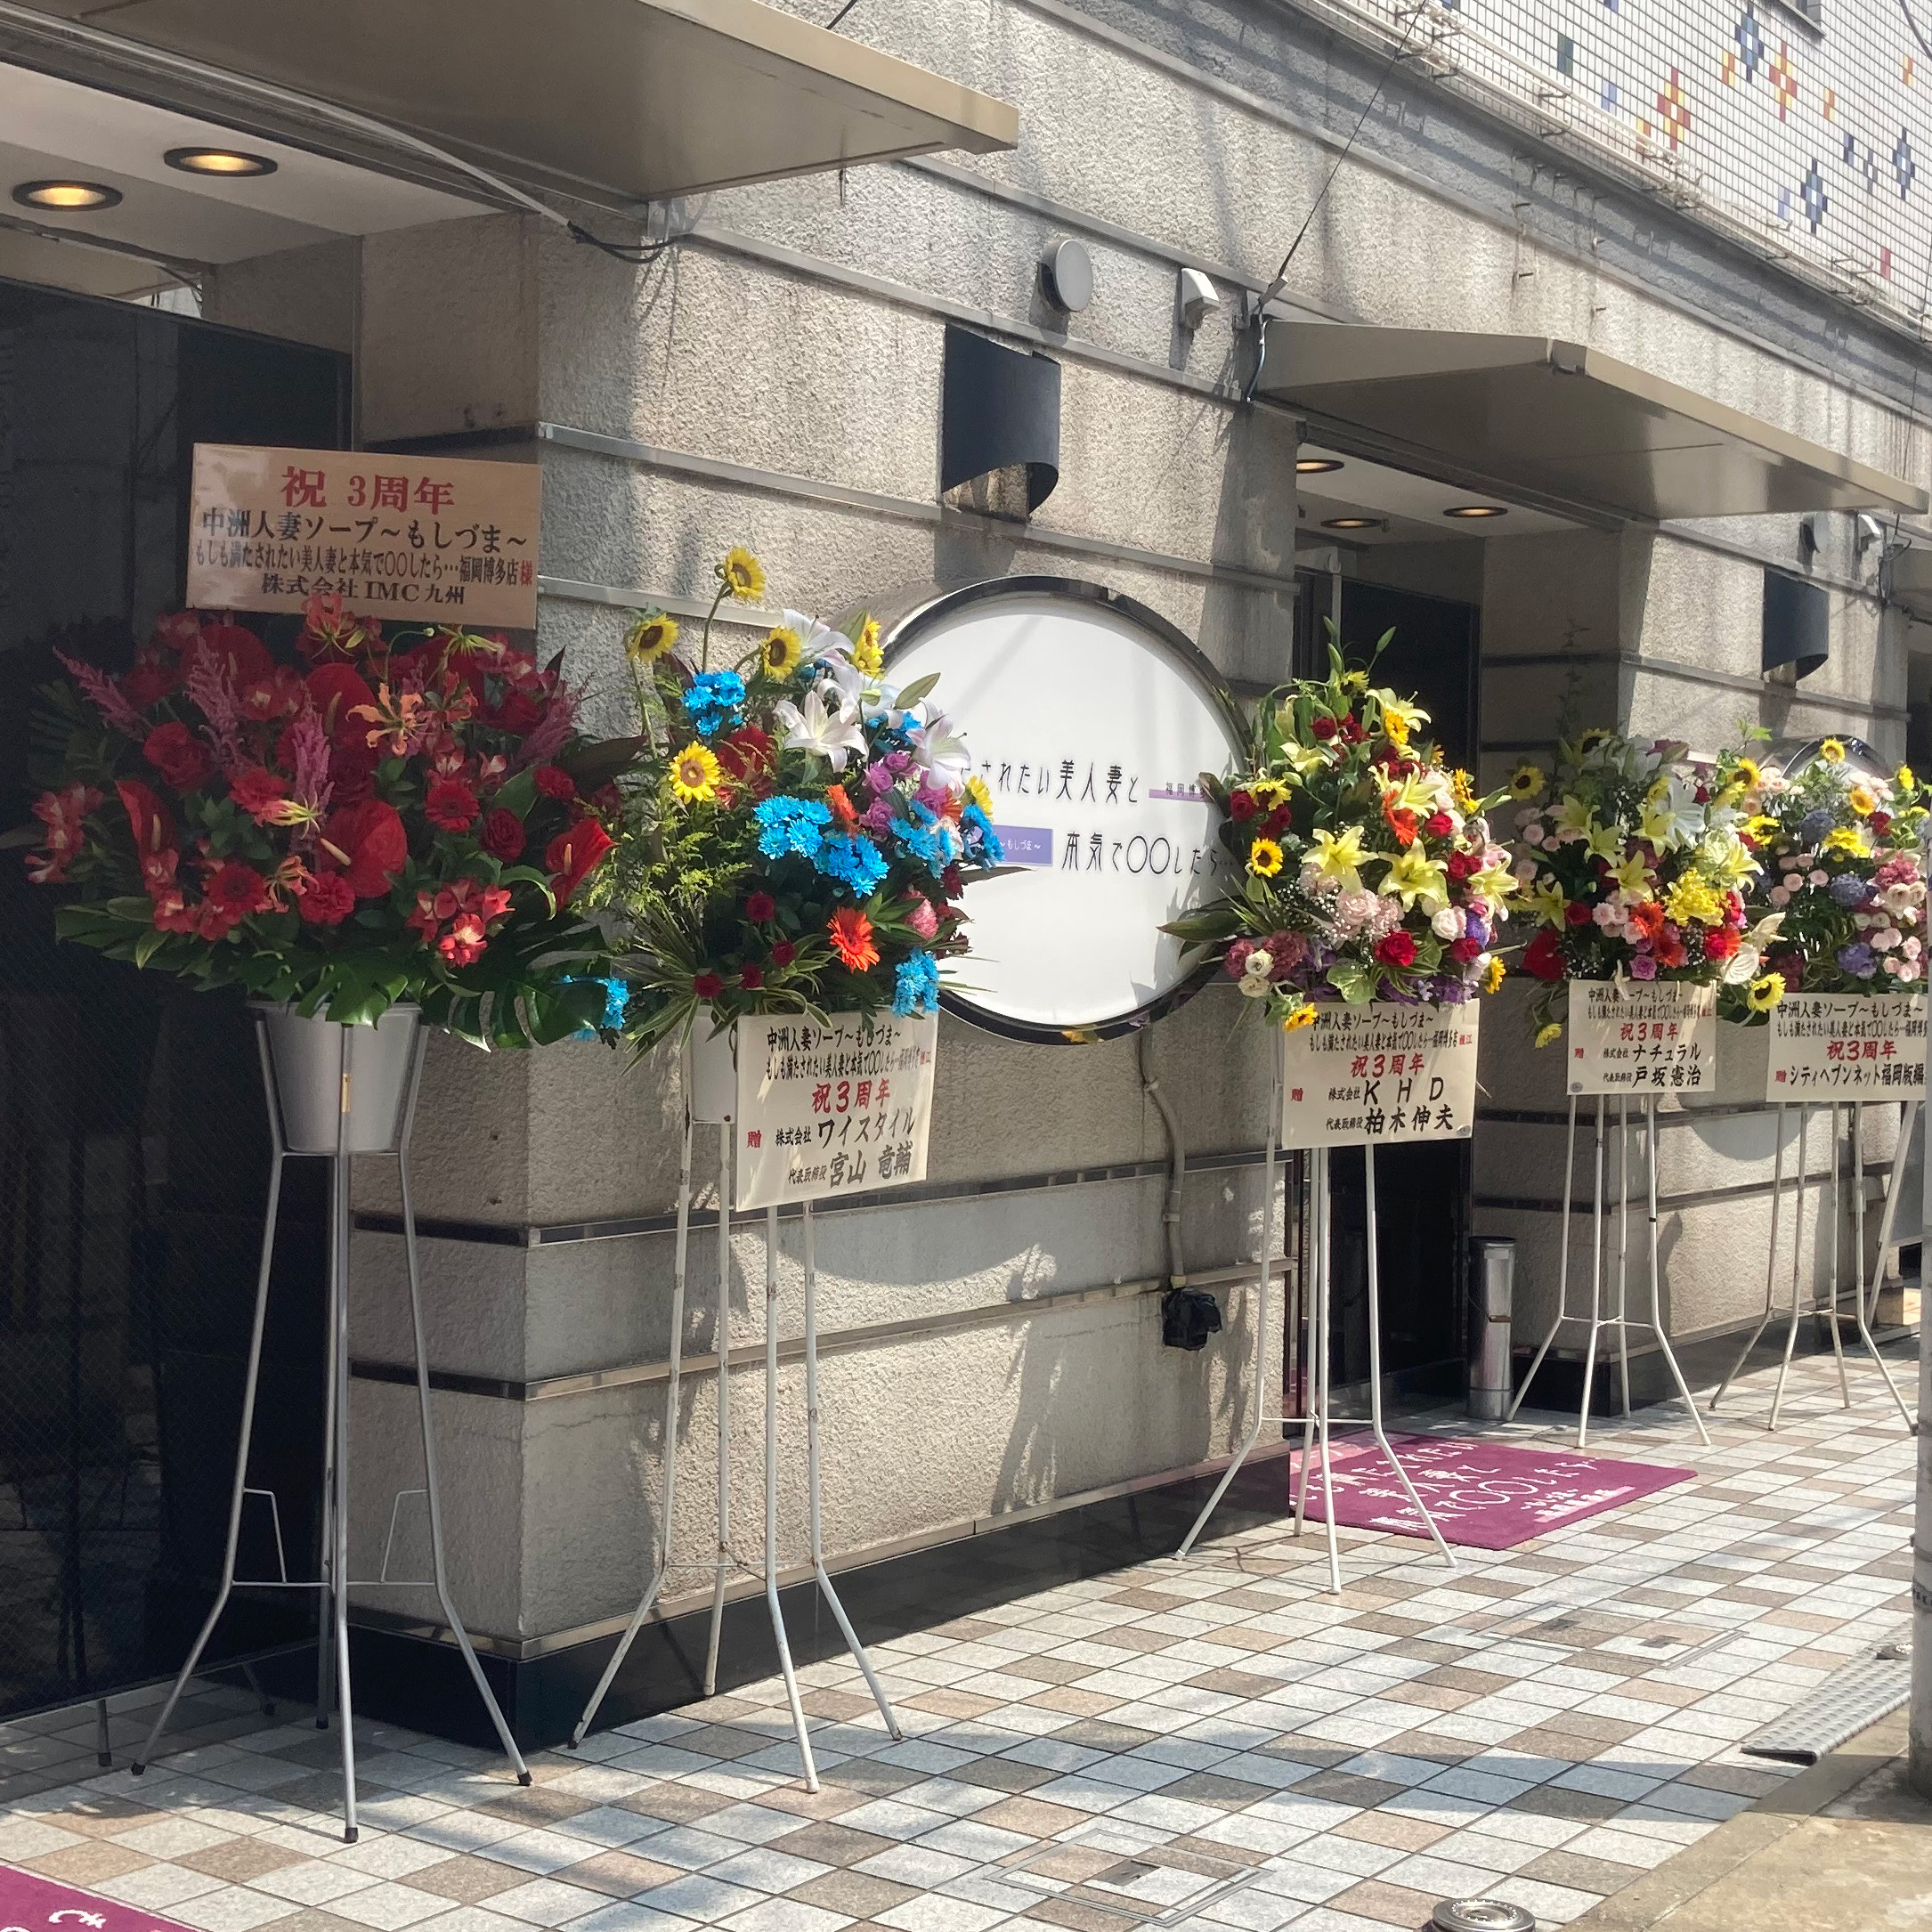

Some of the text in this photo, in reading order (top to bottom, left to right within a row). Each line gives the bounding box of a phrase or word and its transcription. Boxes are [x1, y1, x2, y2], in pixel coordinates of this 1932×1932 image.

[280, 466, 456, 515] 祝 3周年
[1620, 1022, 1678, 1042] 祝3周年
[1351, 1052, 1425, 1078] 祝3周年
[1827, 1040, 1897, 1061] 祝3周年
[811, 1078, 890, 1114] 祝3周年
[818, 1107, 915, 1149] ワイスタイル
